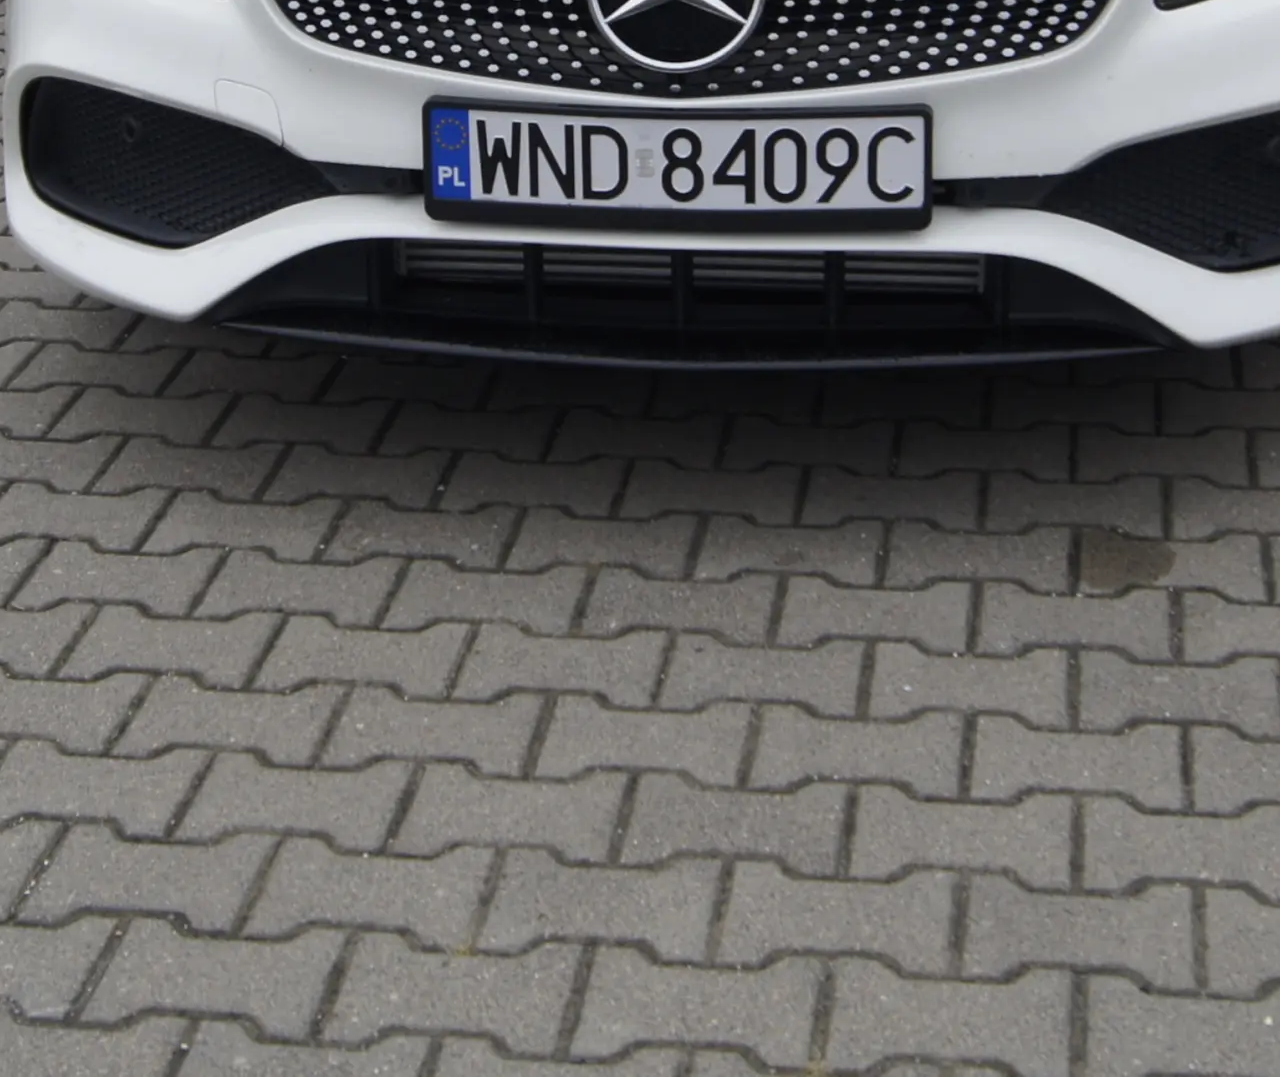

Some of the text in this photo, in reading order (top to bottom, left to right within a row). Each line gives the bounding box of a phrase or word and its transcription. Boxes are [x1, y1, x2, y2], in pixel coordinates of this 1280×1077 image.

[437, 166, 466, 188] PL
[476, 119, 916, 204] WND 8409C
